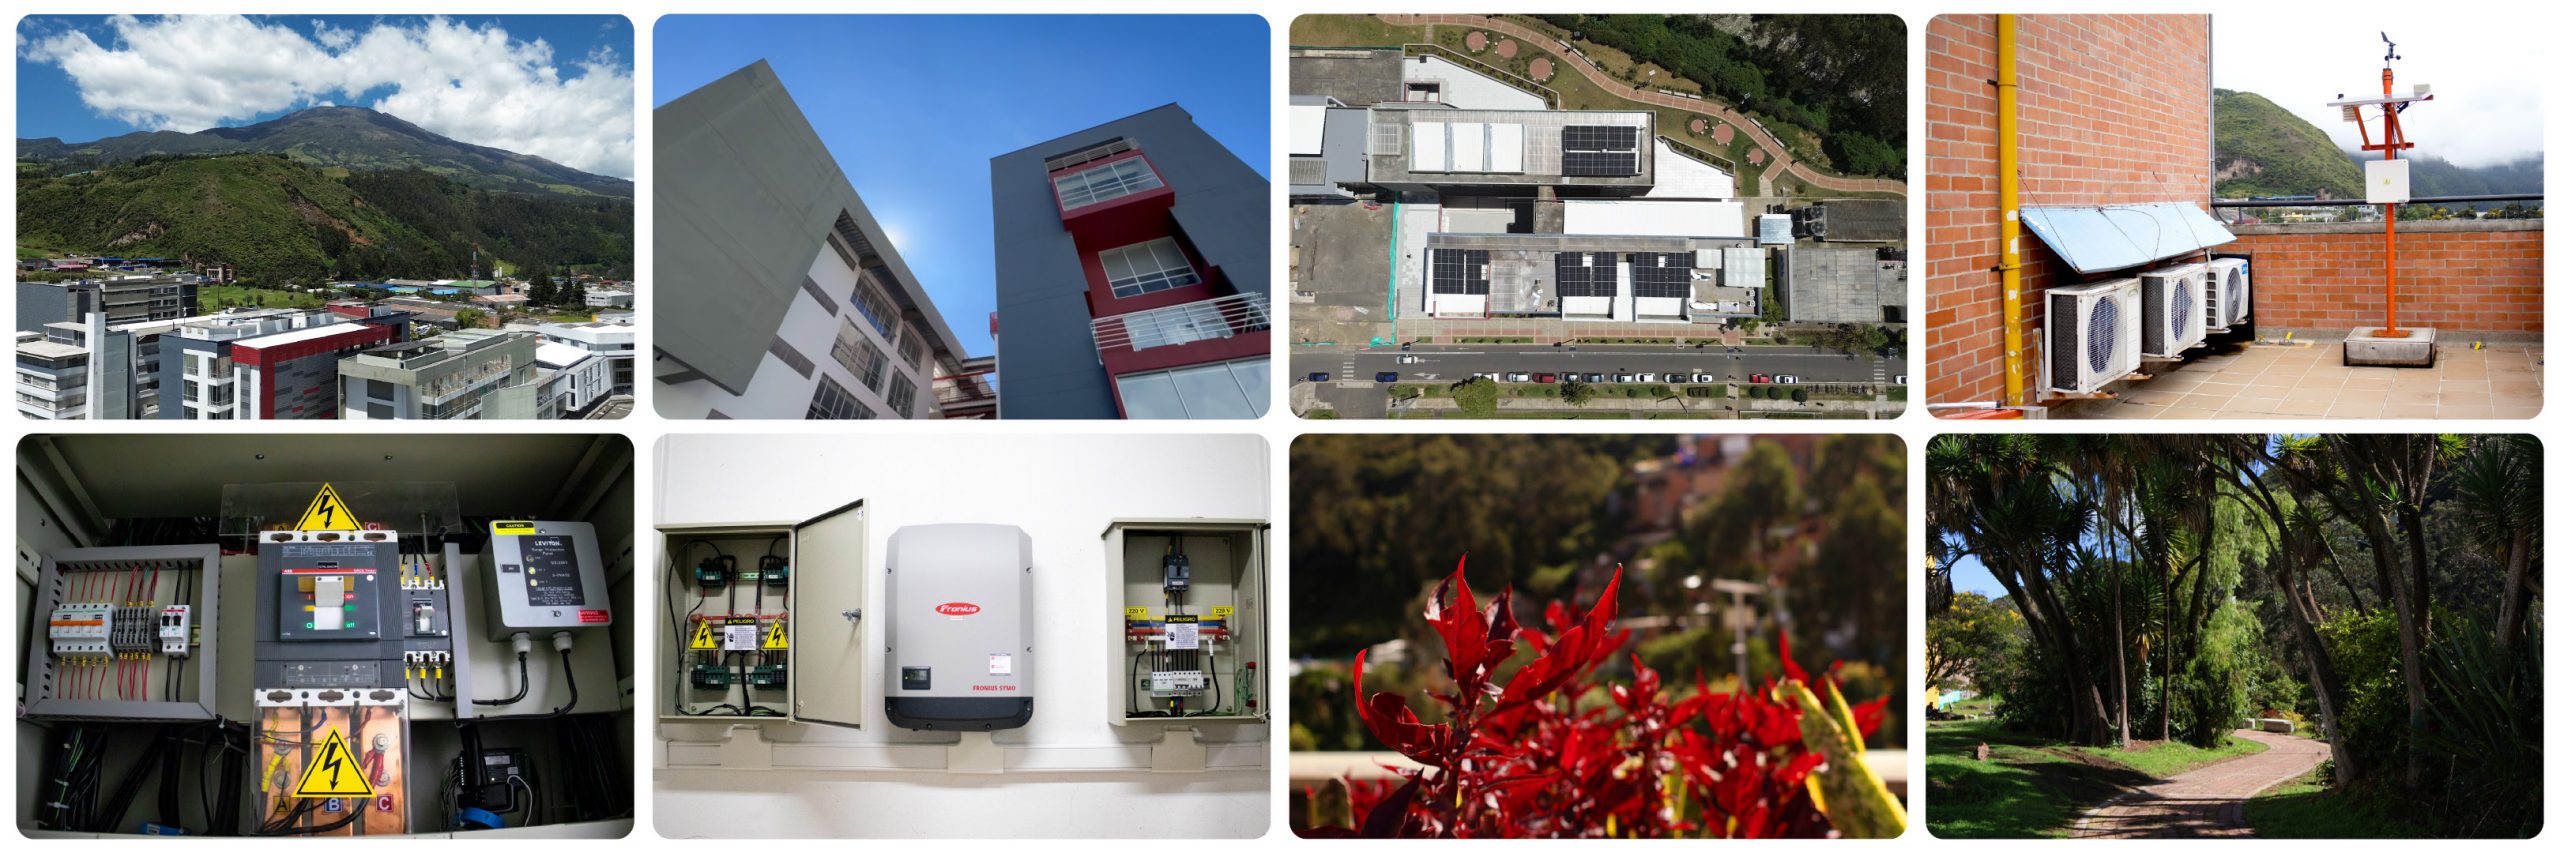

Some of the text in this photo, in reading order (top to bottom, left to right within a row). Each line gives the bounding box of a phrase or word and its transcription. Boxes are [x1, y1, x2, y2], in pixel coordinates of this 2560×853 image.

[940, 605, 977, 613] Fronius
[275, 797, 287, 810] A
[329, 798, 340, 811] B
[378, 797, 390, 810] C
